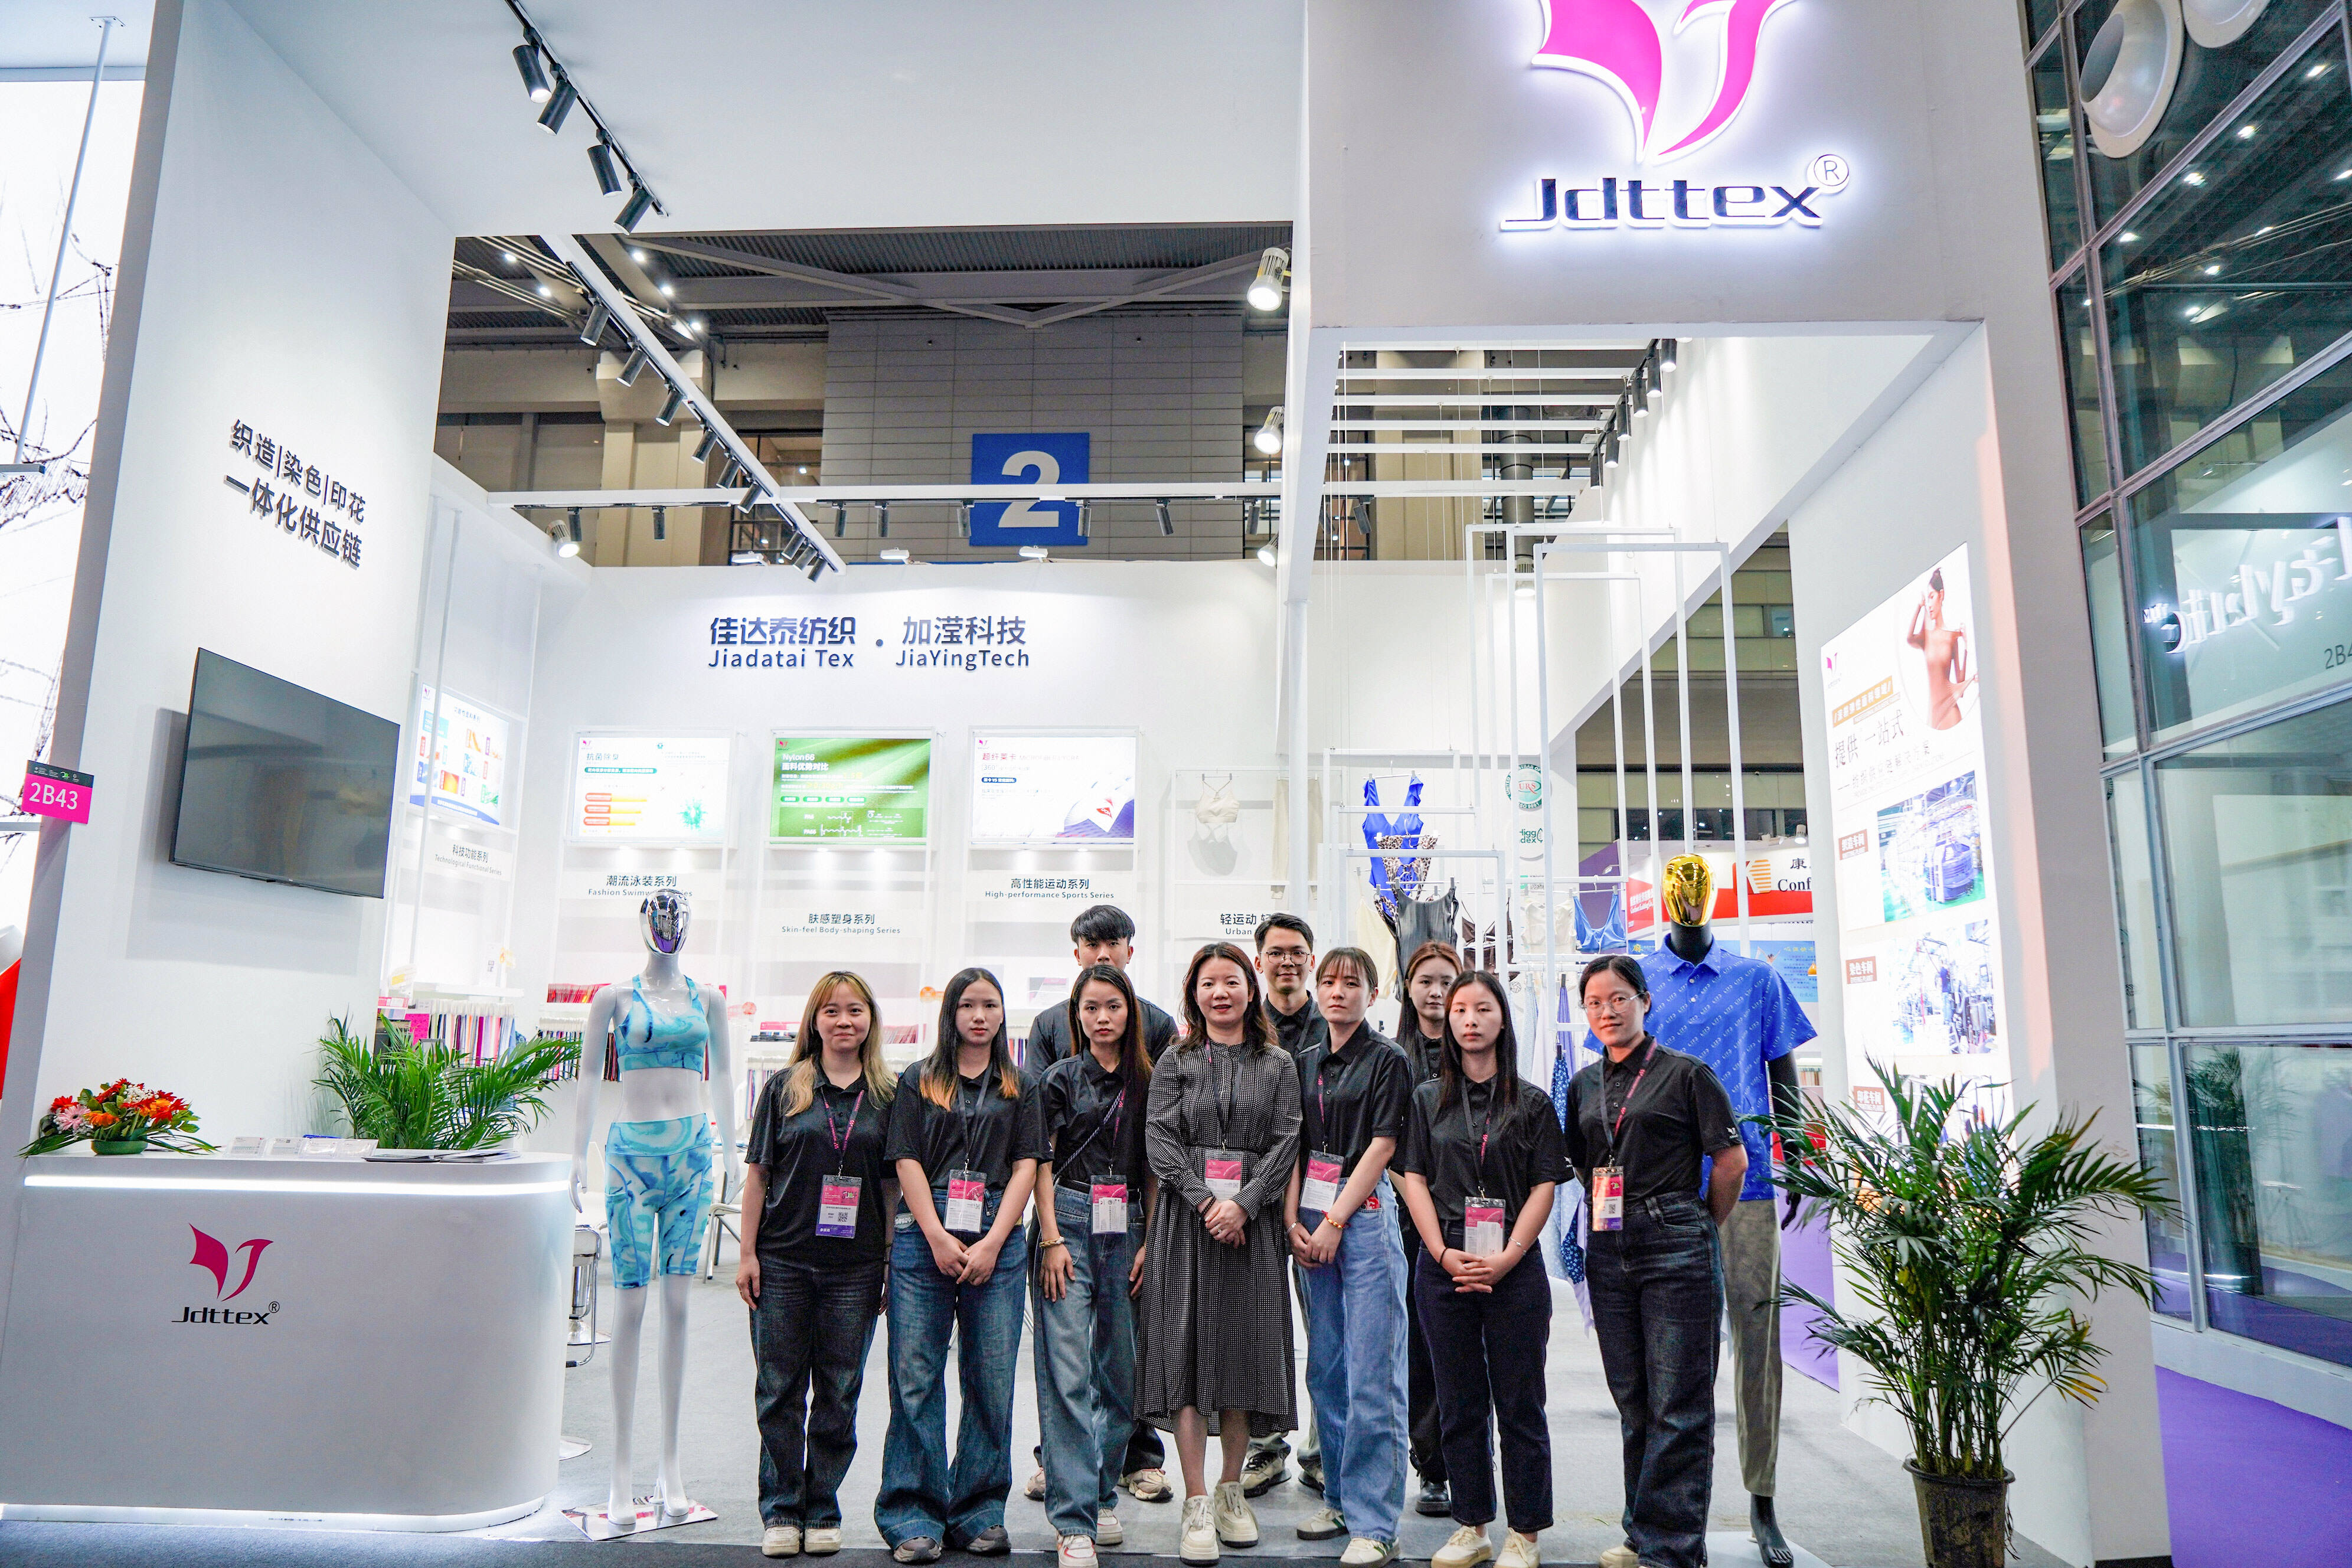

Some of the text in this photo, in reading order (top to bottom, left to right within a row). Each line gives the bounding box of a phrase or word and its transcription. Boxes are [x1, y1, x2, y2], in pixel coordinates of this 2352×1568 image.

[998, 450, 1060, 528] 2
[224, 475, 362, 570] 一体化供应链
[710, 617, 856, 645] 佳达泰纺织
[903, 616, 1027, 645] 加滢科技
[708, 648, 854, 668] Jiadatai Tex
[895, 649, 1030, 671] JiaYingTech
[982, 753, 1017, 761] 超纤莱卡
[782, 763, 829, 772] 面料优势对比
[29, 782, 78, 810] 2B43
[452, 844, 489, 863] 科技功能系列
[435, 854, 502, 876] Technological Functional Series
[606, 875, 677, 887] 潮流泳装系列
[1011, 878, 1090, 889] 高性能运动系列
[985, 891, 1060, 899] High-performance
[808, 913, 876, 925] 肤感塑身系列
[1220, 913, 1257, 925] 轻运动
[819, 926, 875, 935] Body-shaping
